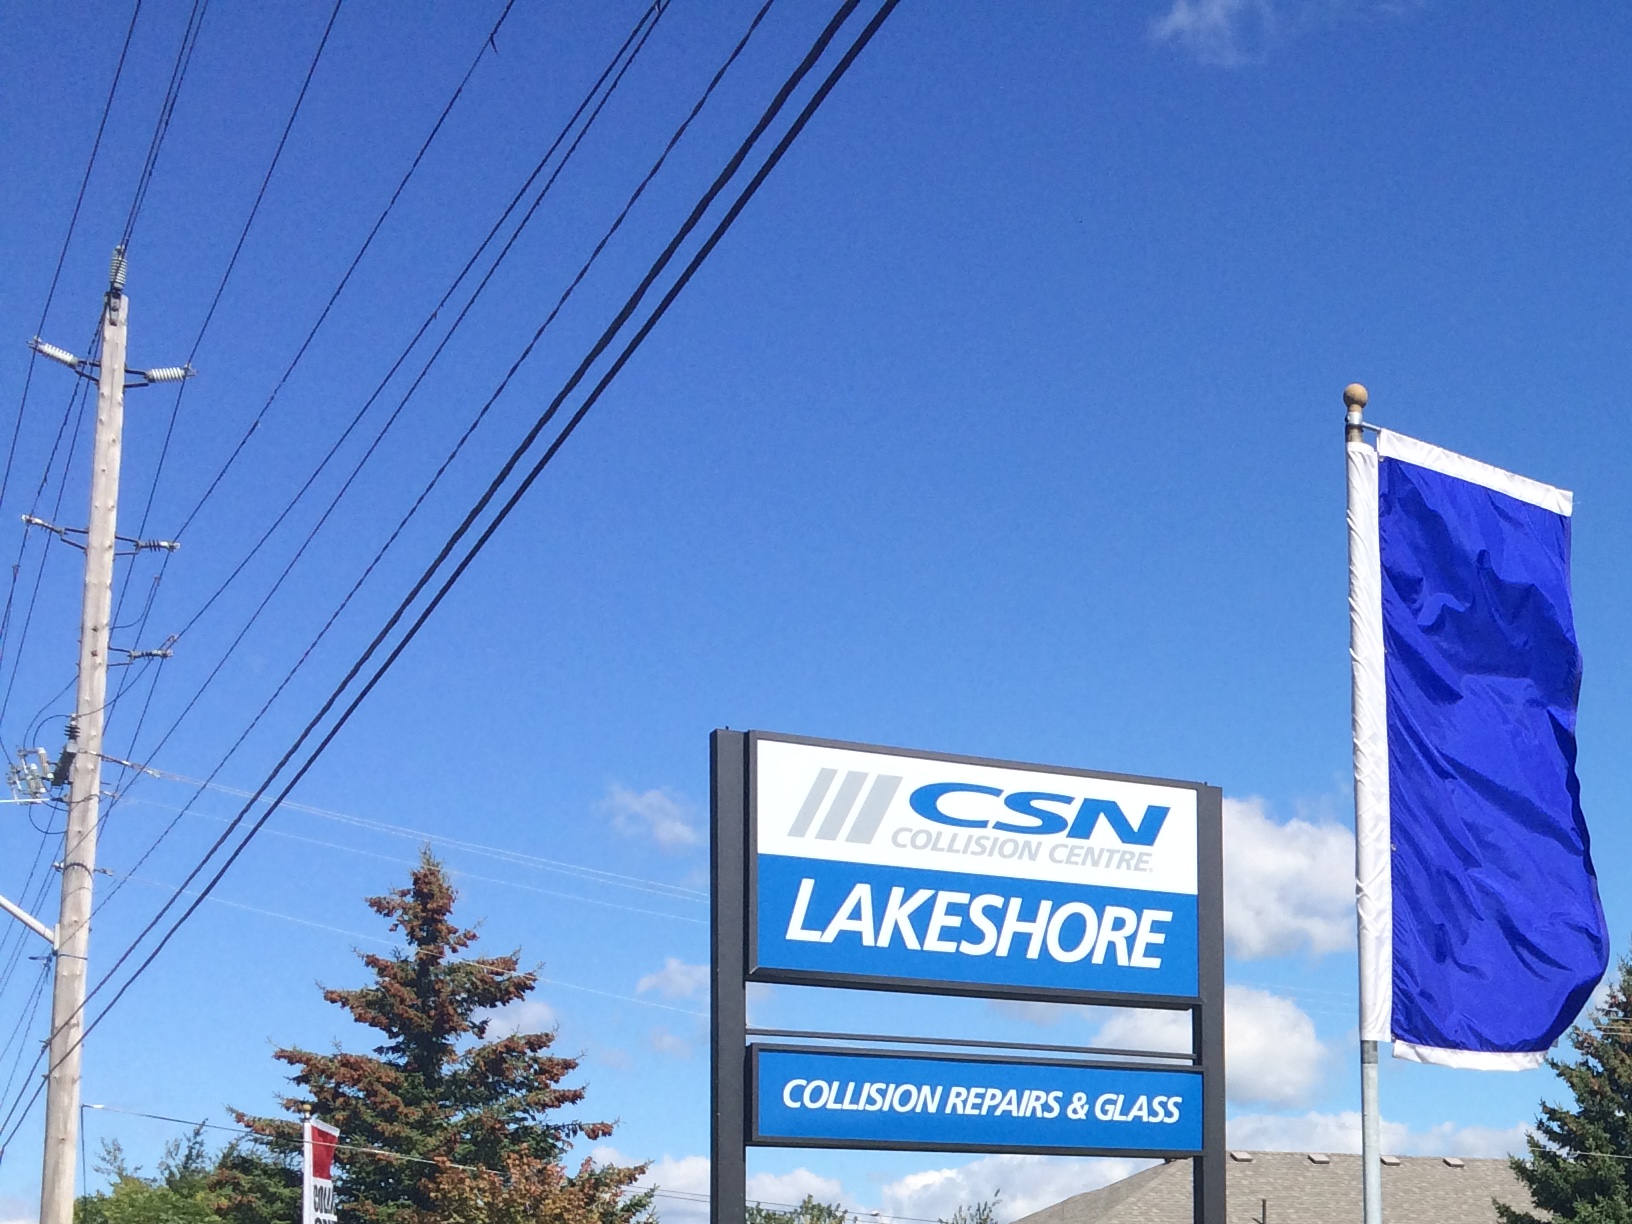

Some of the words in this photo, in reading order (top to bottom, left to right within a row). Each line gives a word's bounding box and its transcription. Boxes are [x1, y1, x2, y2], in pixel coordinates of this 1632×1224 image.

[909, 782, 1171, 847] CSN
[891, 827, 1042, 861] COLLISION
[1048, 843, 1153, 872] CENTRE
[785, 878, 1174, 969] LAKESHORE
[782, 1079, 943, 1114] COLLISION
[944, 1087, 1061, 1119] REPAIRS
[1066, 1094, 1088, 1120] &
[1094, 1092, 1182, 1125] GLASS
